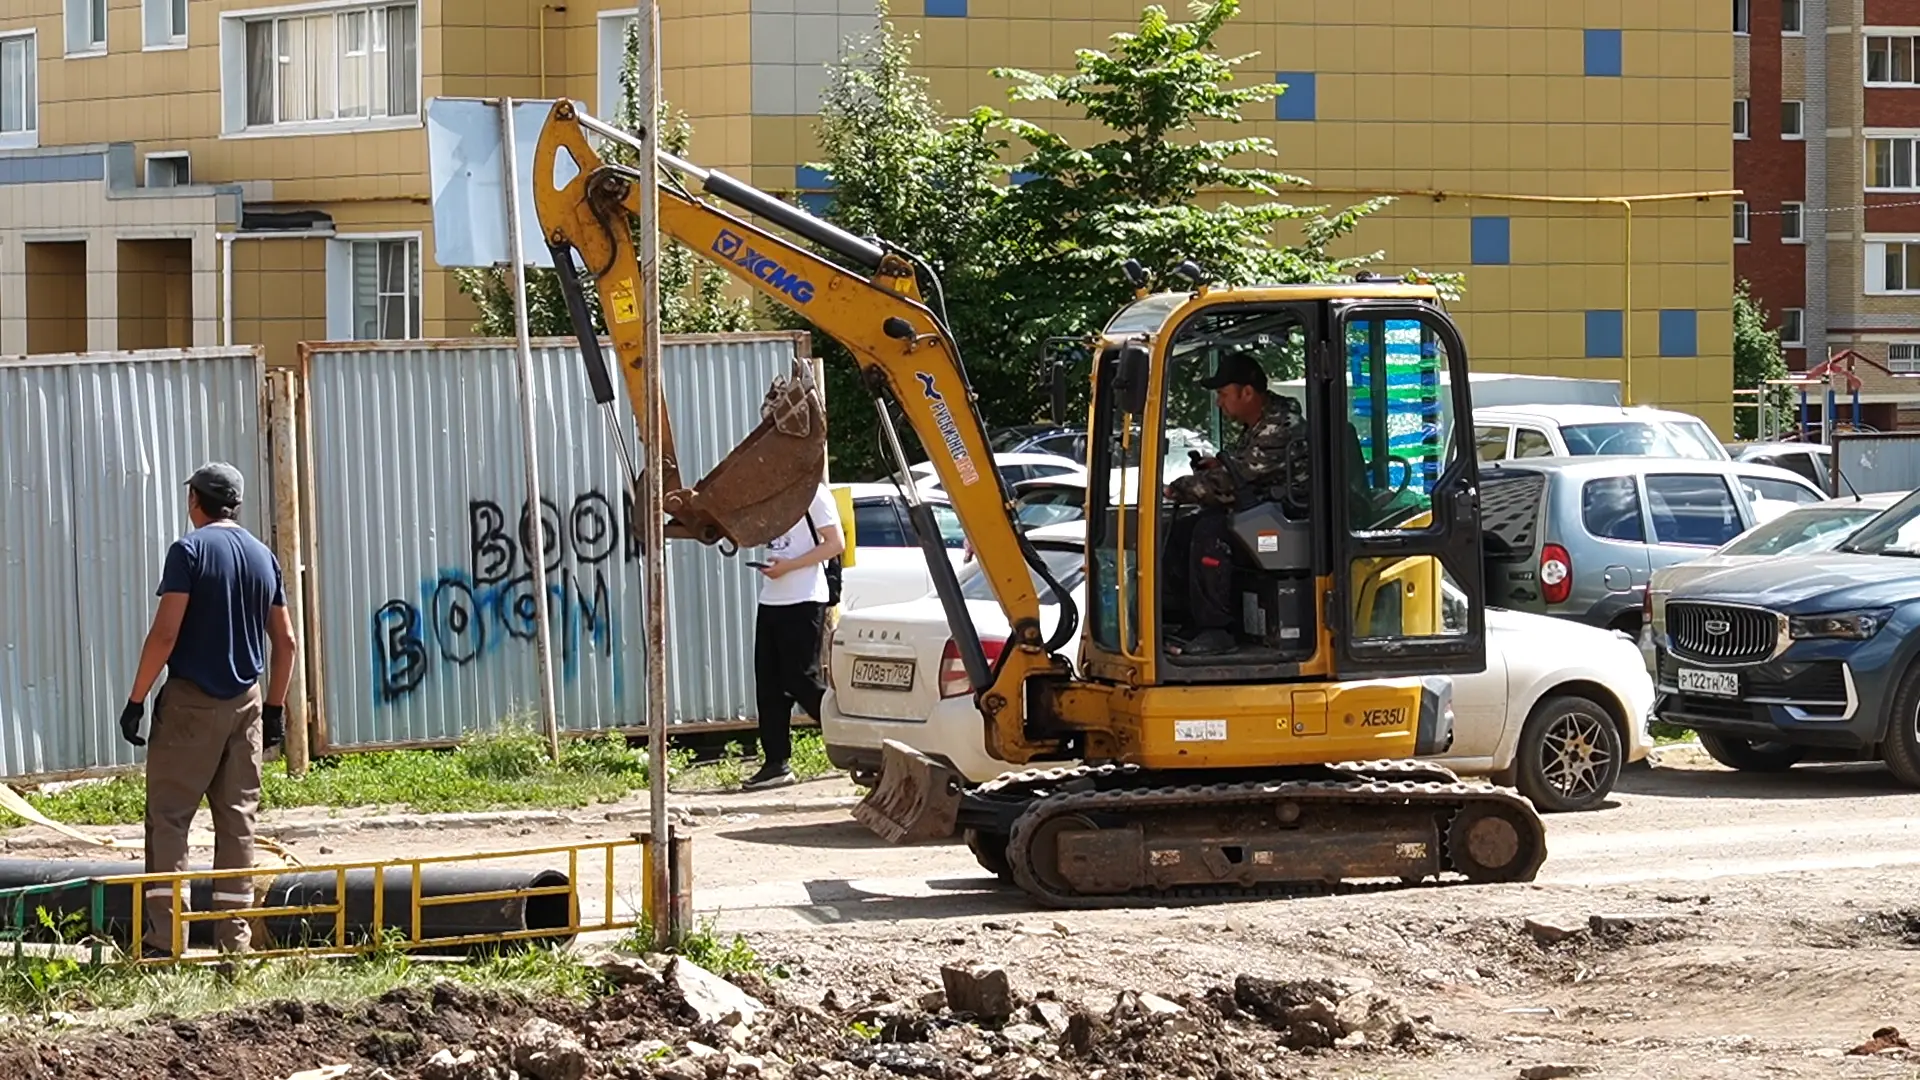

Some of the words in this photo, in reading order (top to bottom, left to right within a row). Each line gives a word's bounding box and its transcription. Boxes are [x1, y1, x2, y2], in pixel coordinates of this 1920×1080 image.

[735, 246, 815, 304] XCMG
[858, 629, 901, 641] LADA
[1360, 707, 1406, 727] XE35U
